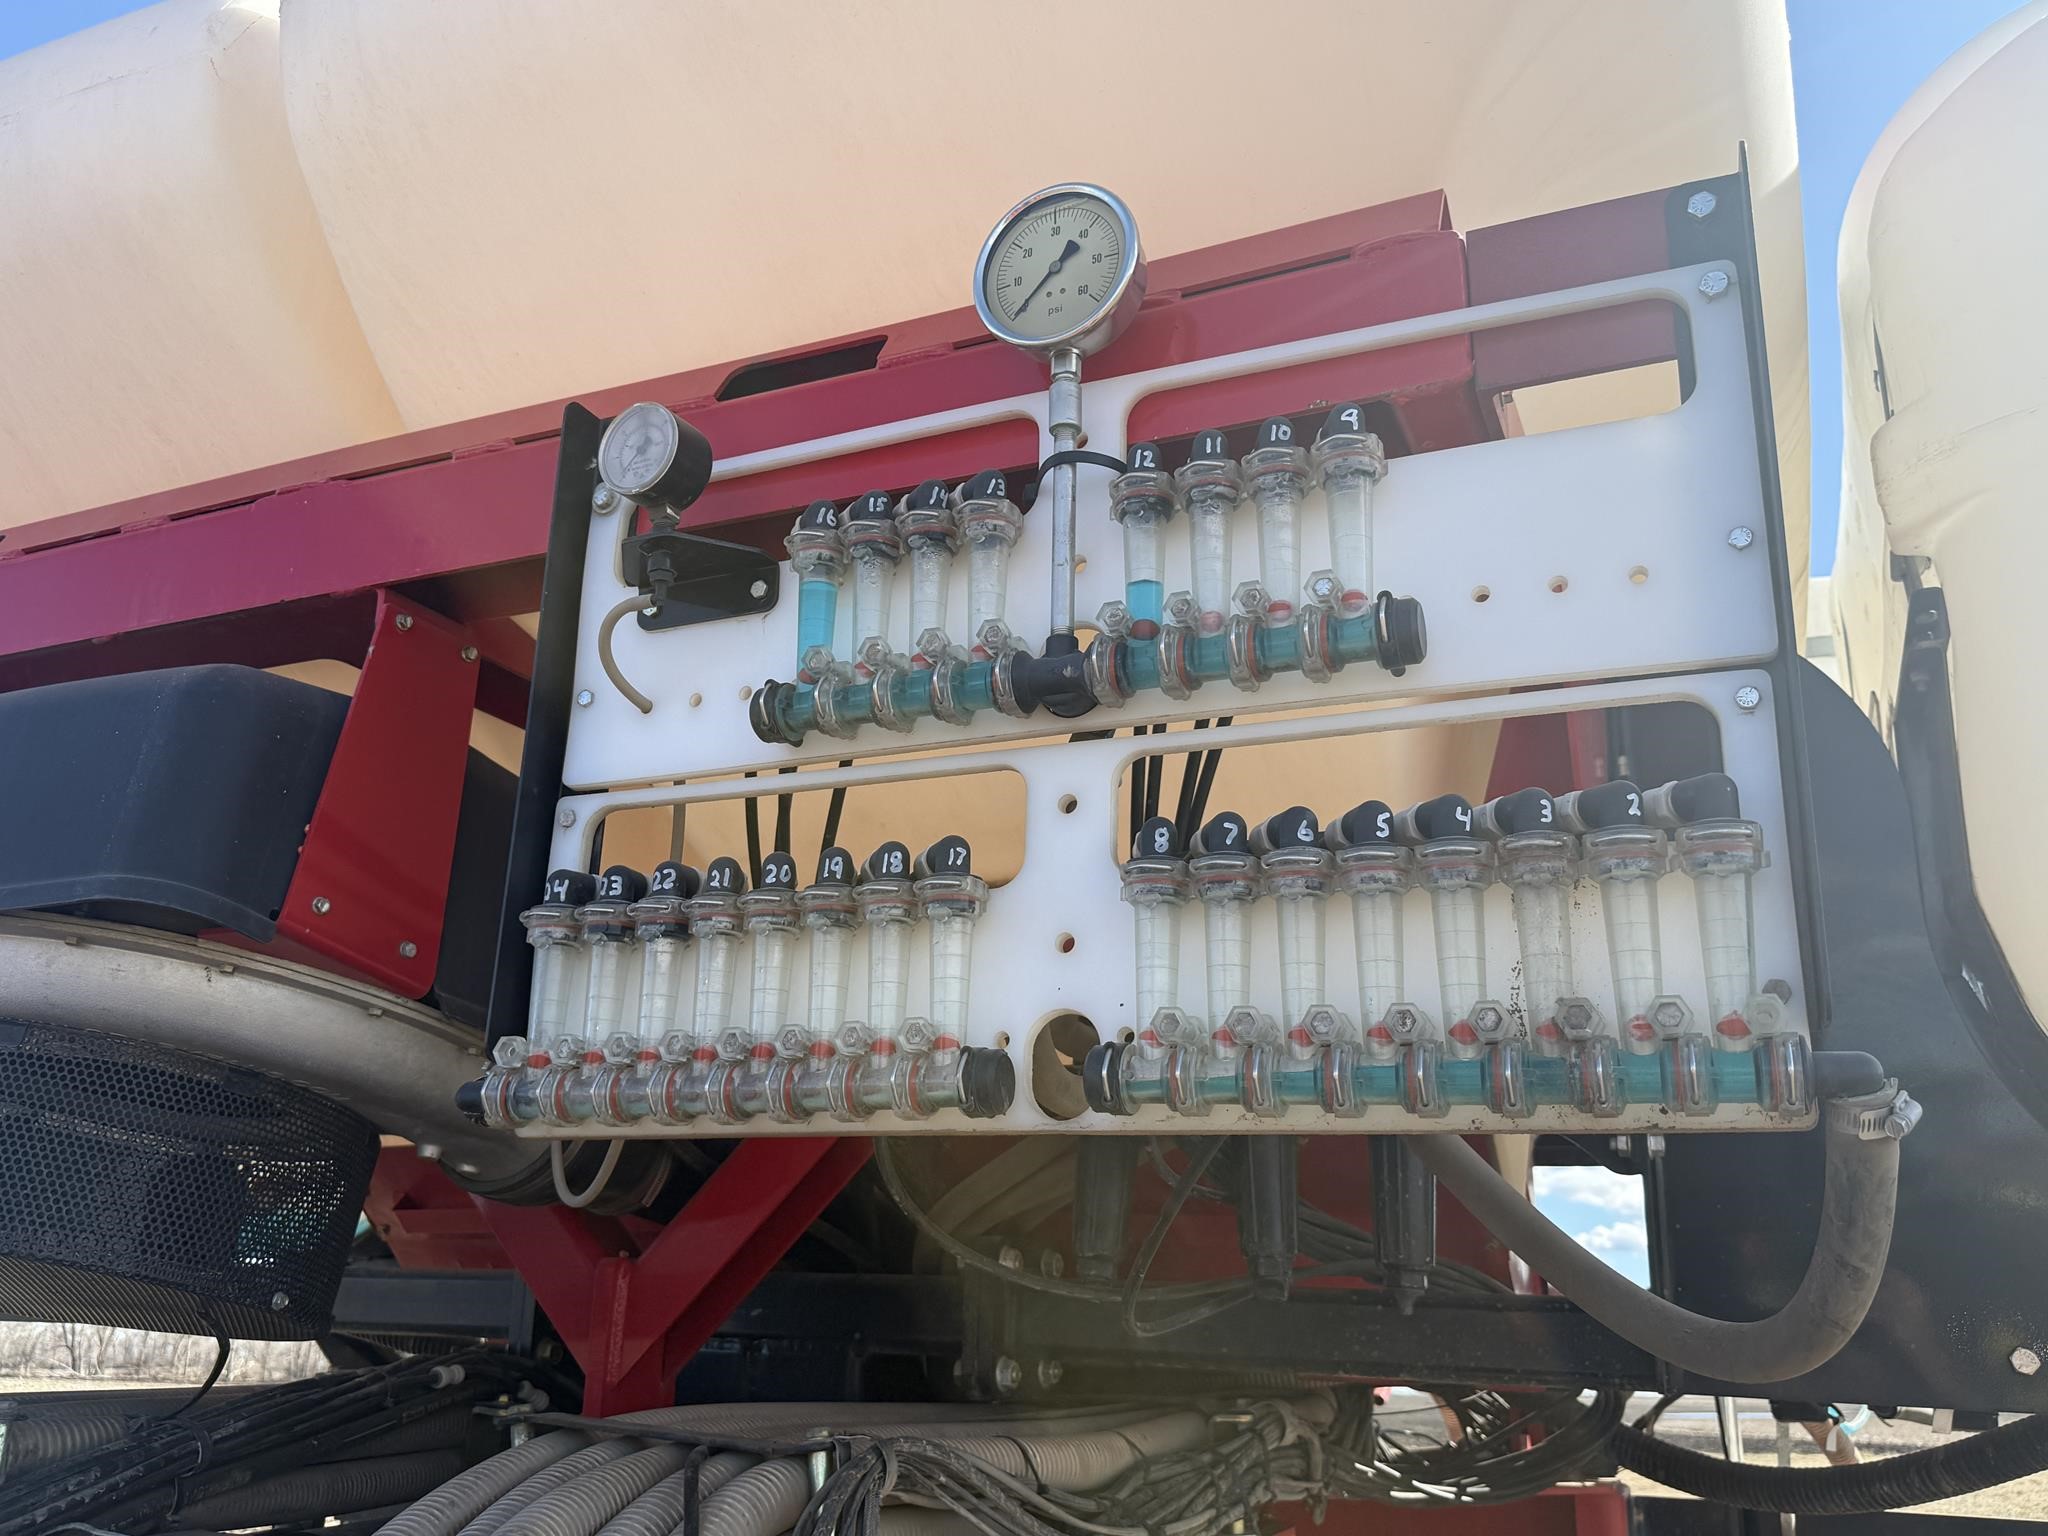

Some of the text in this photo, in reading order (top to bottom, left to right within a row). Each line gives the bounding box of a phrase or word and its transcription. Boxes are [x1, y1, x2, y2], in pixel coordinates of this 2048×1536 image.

[1050, 226, 1061, 238] 30
[1078, 227, 1089, 239] 40
[1022, 248, 1033, 259] 20
[1091, 254, 1102, 264] 50
[1013, 276, 1023, 287] 10
[1077, 284, 1089, 295] 60
[1048, 304, 1063, 316] psi
[1340, 408, 1359, 431] 9
[1270, 424, 1292, 441] 10
[1205, 436, 1221, 454] 11
[1134, 449, 1156, 468] 12
[986, 478, 1006, 496] 13
[868, 496, 888, 513] 15
[929, 486, 949, 509] 14
[816, 507, 837, 527] 16
[1539, 798, 1553, 823] 3
[1626, 792, 1641, 817] 2
[1376, 812, 1391, 838] 5
[1454, 807, 1472, 832] 4
[1154, 826, 1171, 853] 8
[1223, 823, 1239, 846] 7
[1297, 819, 1314, 842] 6
[882, 851, 903, 875] 18
[947, 847, 967, 866] 17
[709, 867, 730, 888] 21
[765, 863, 792, 884] 20
[822, 856, 844, 880] 19
[652, 868, 677, 892] 22
